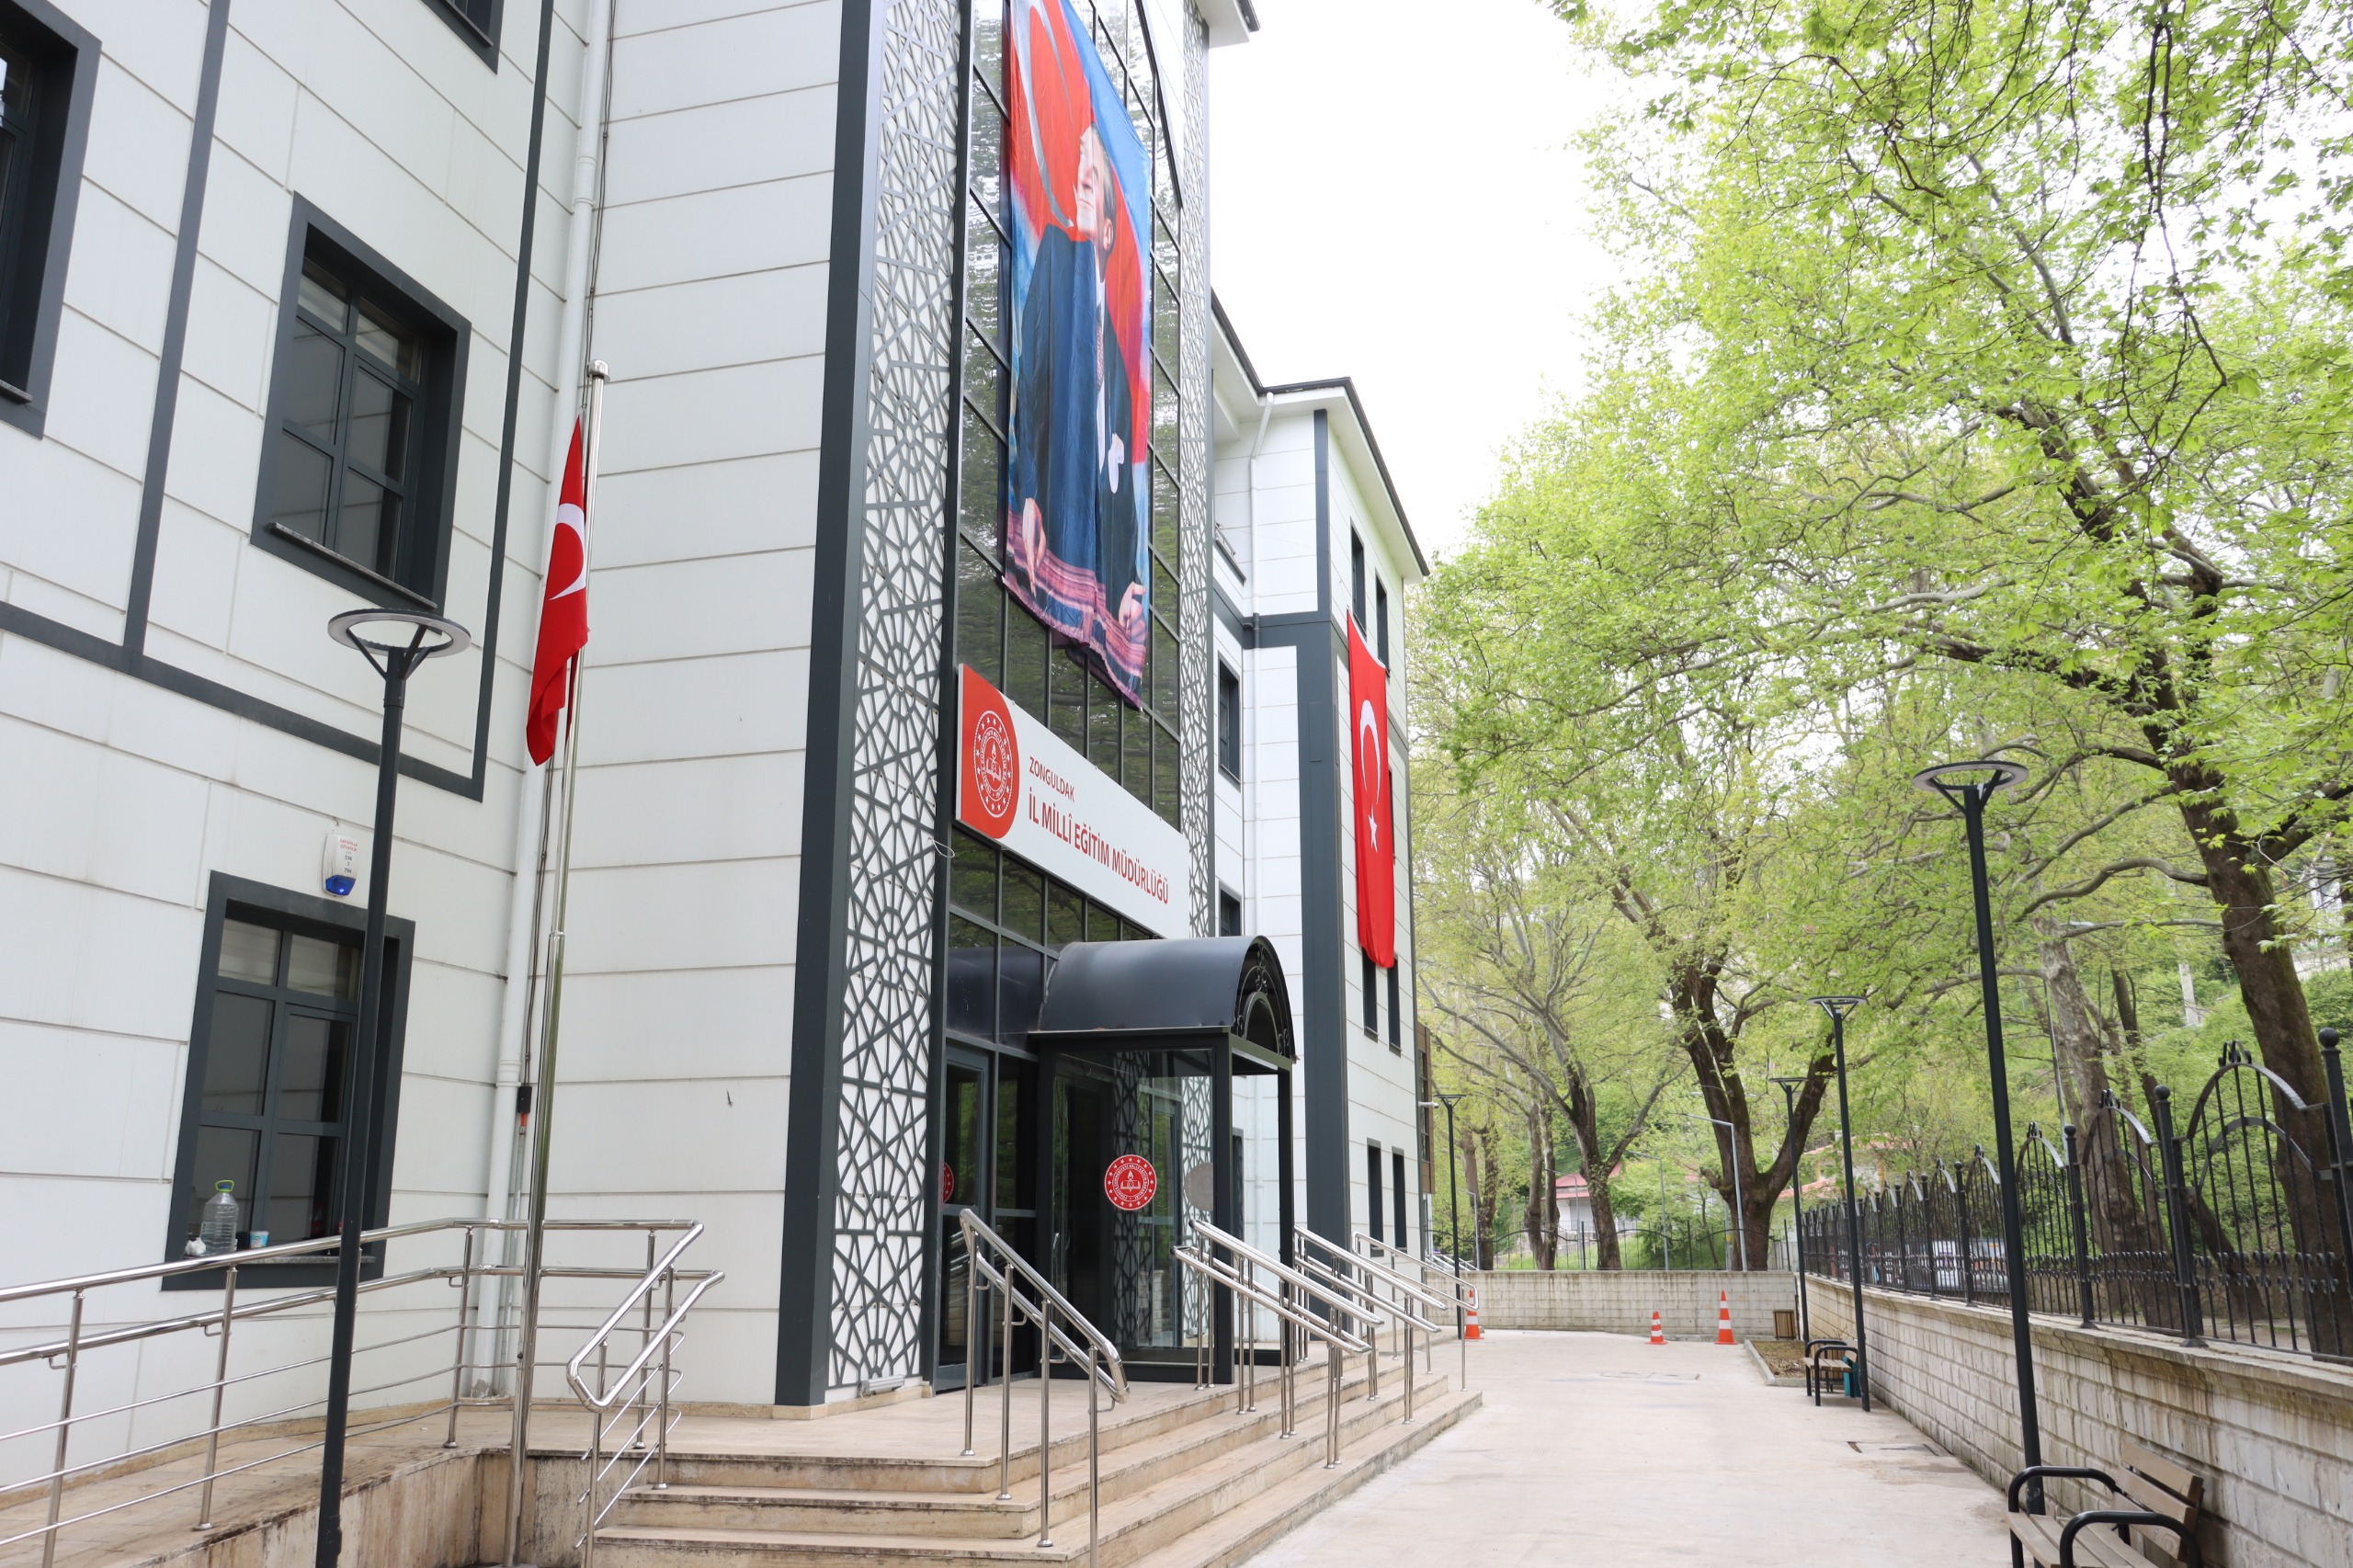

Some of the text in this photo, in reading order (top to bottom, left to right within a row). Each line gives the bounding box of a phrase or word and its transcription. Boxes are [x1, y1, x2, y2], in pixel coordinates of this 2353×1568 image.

[1029, 756, 1074, 802] ZONGULDAK
[1029, 786, 1168, 904] İL MİLLÎ EĞİTİM MÜDÜRLÜĞÜ
